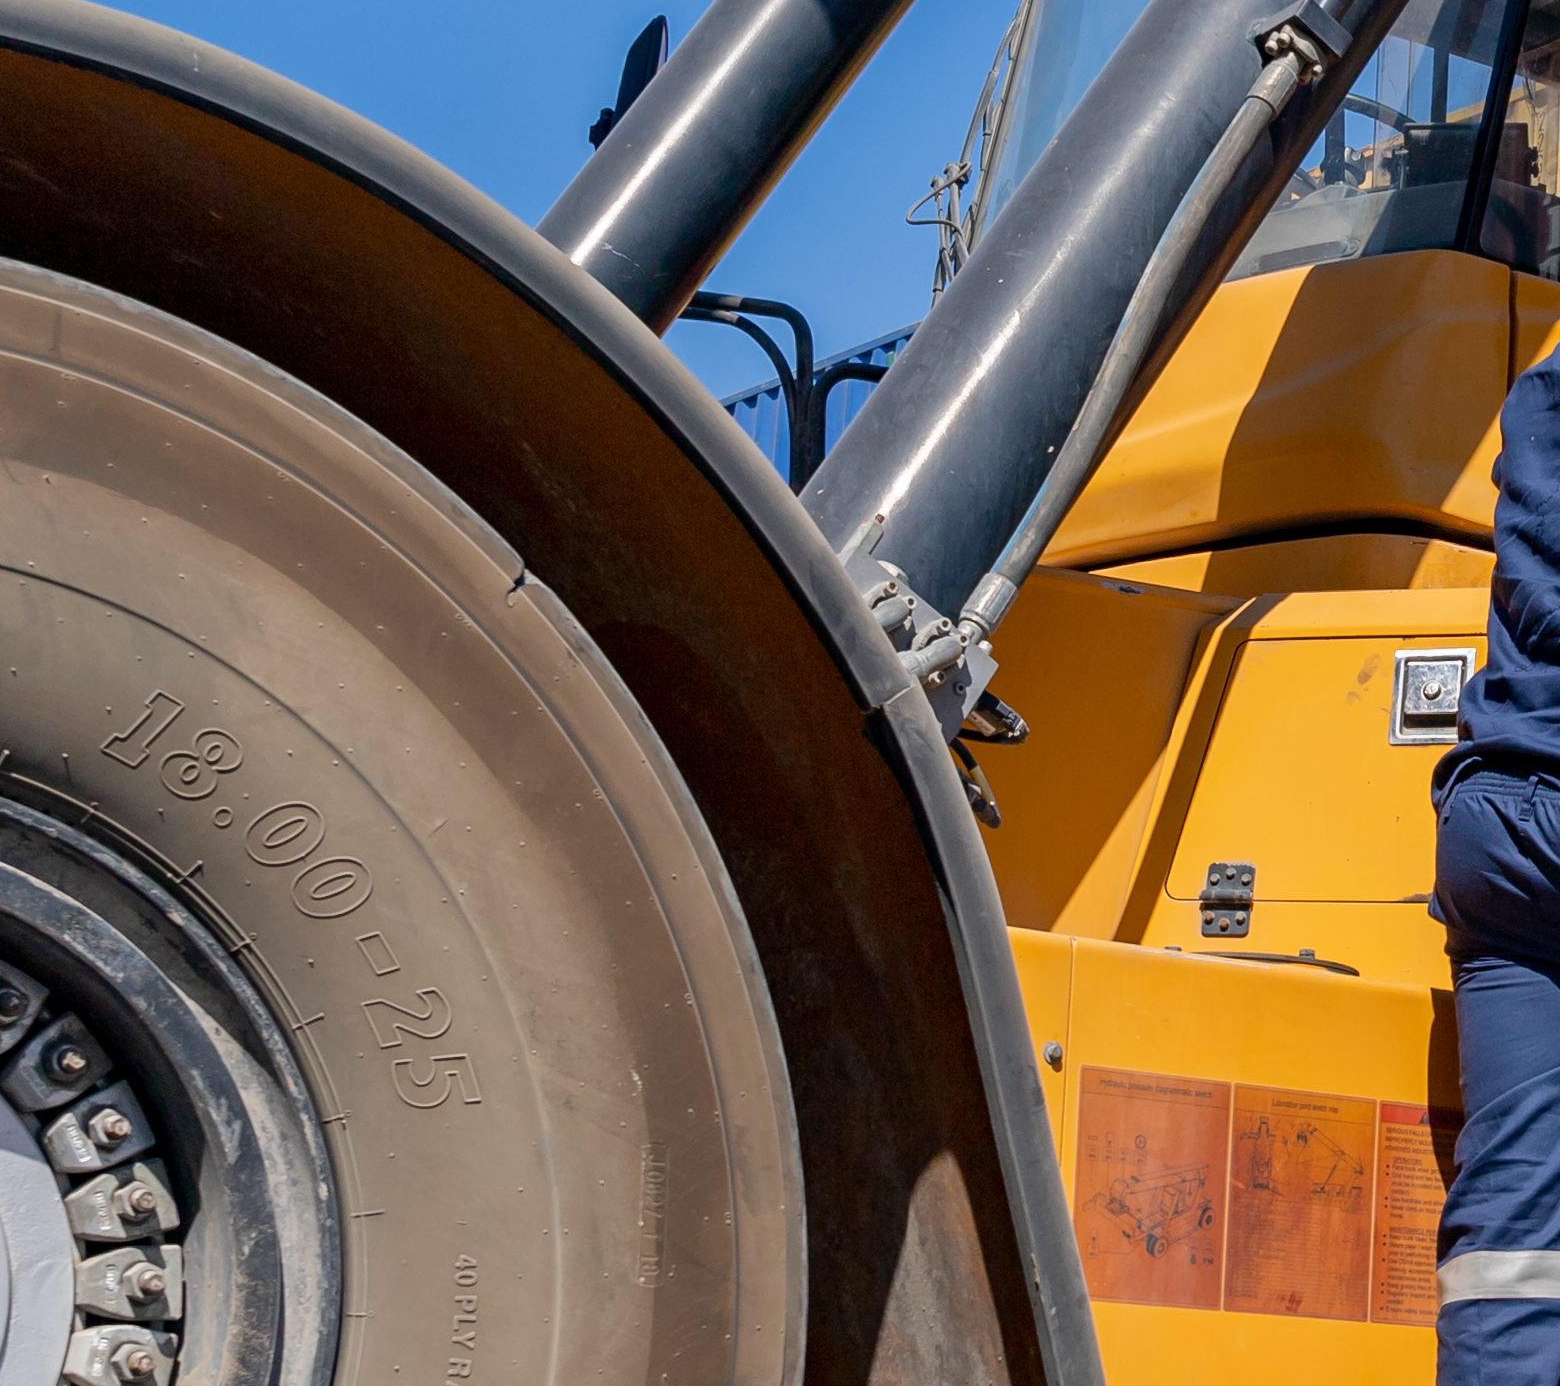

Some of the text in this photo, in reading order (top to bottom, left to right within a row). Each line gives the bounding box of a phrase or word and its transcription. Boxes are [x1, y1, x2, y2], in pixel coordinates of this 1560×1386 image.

[100, 688, 482, 1109] 18.00-25
[453, 1253, 479, 1288] 40
[451, 1294, 479, 1351] PLY
